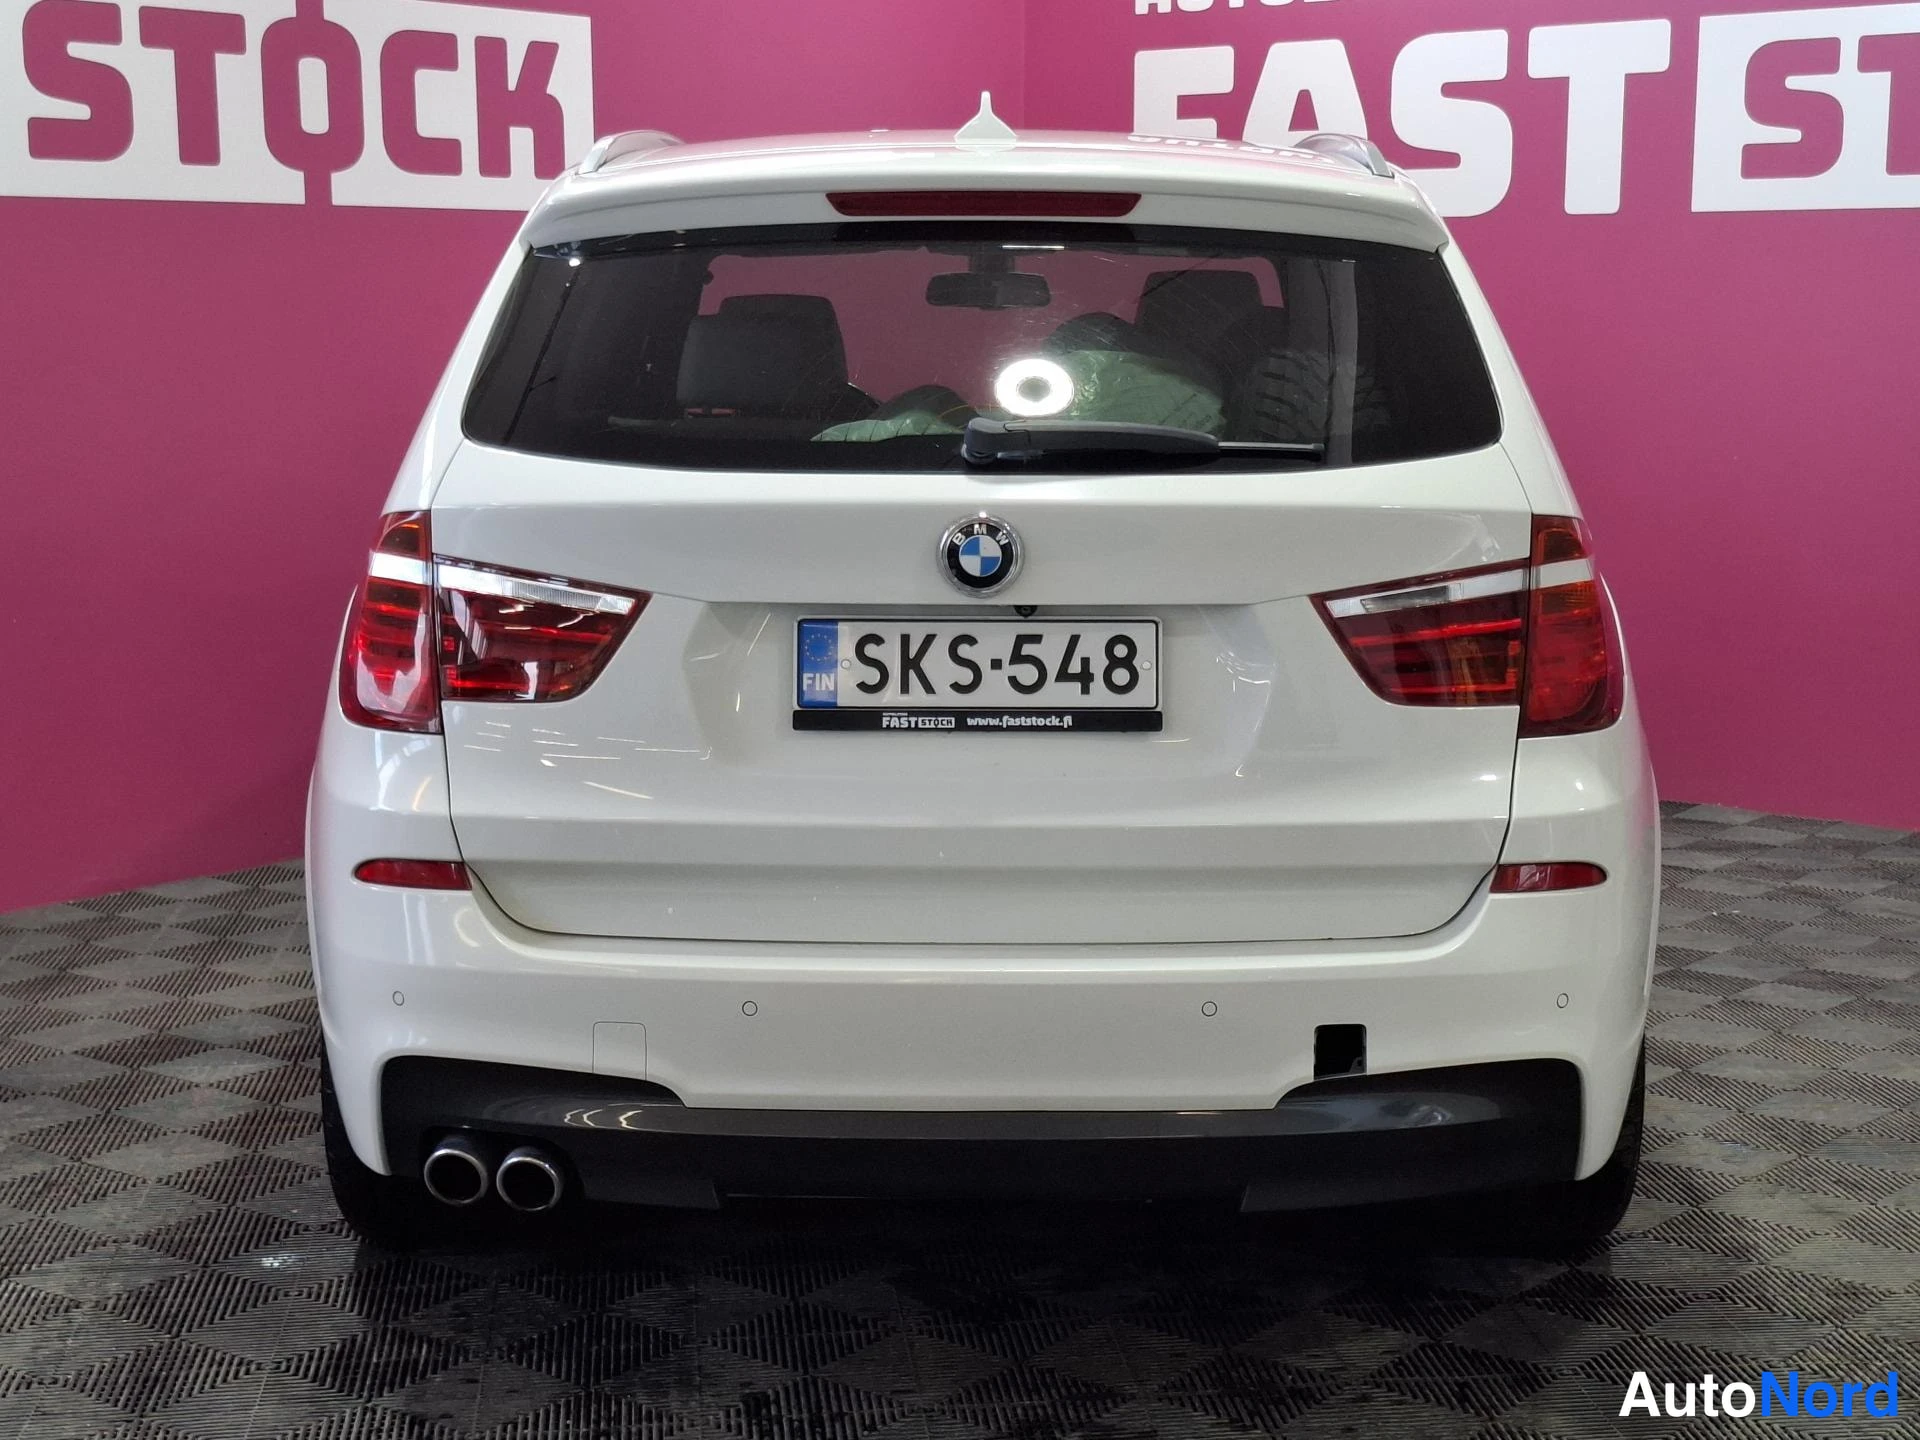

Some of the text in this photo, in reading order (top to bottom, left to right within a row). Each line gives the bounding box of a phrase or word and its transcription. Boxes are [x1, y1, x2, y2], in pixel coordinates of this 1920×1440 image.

[22, 0, 566, 180] STOCK
[951, 523, 1009, 546] BMW
[854, 633, 1139, 695] SKS-548
[803, 673, 834, 690] FIN
[882, 716, 1072, 729] FAST STOCK www.faststock.fi
